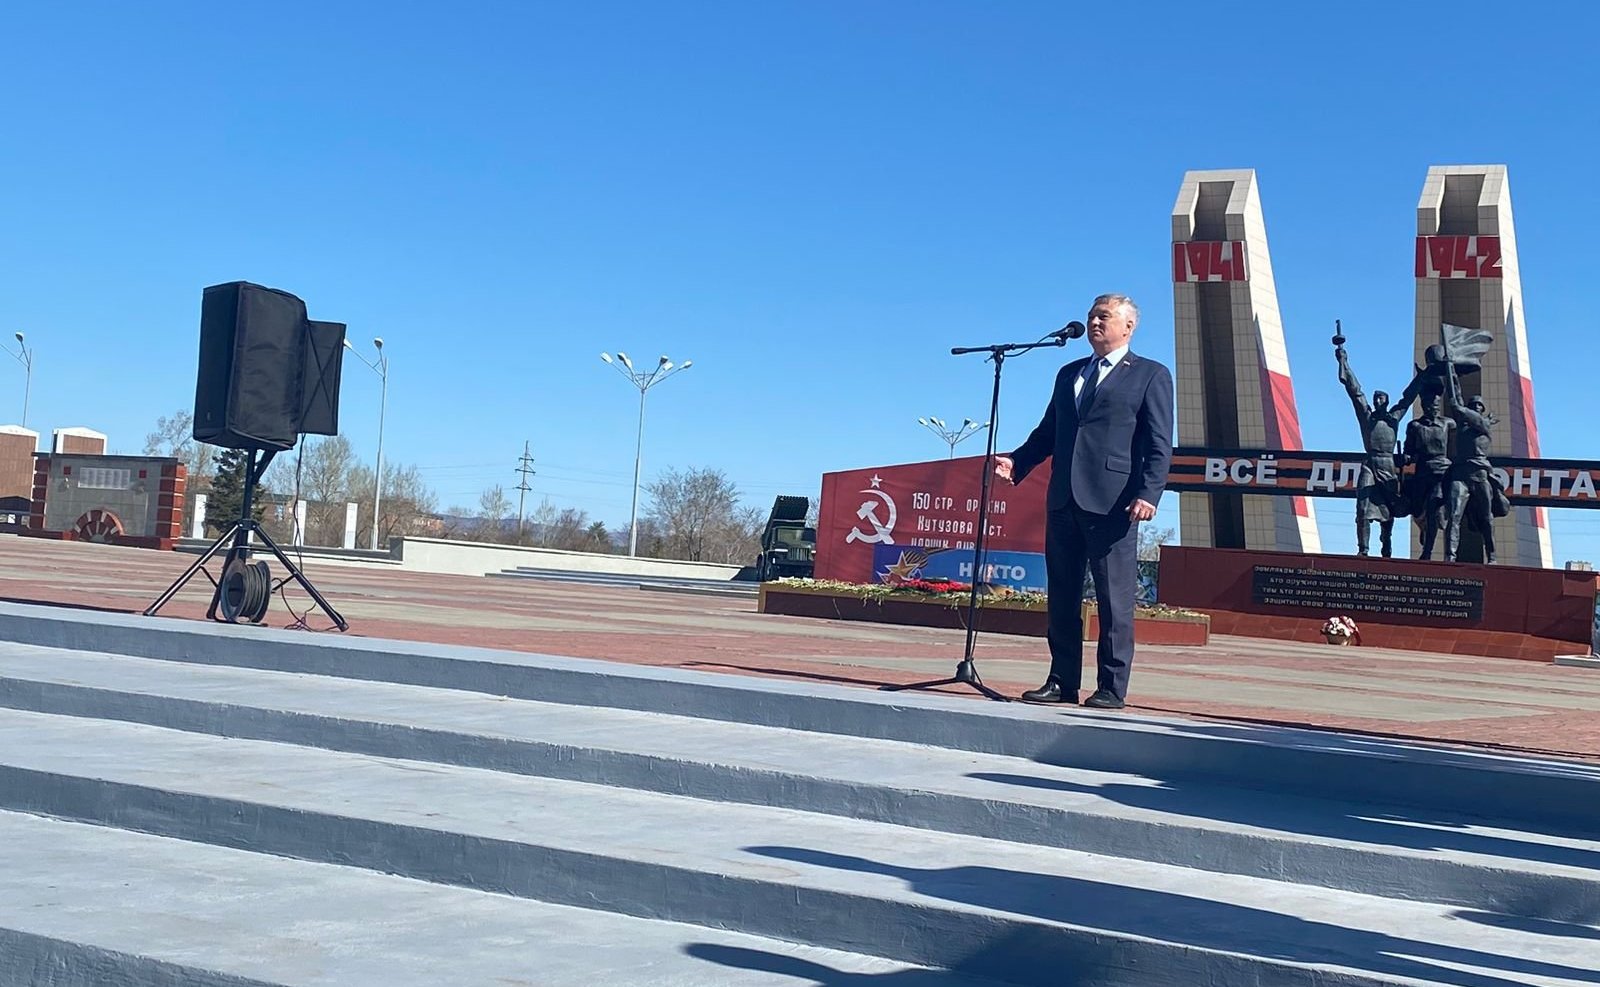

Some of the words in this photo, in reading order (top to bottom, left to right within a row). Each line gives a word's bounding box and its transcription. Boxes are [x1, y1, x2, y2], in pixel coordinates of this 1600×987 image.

[1173, 242, 1248, 282] 1941
[1415, 235, 1503, 278] 1942
[1204, 454, 1278, 485] ВСЁ
[1306, 461, 1362, 493] ДЛ
[912, 492, 930, 510] 150
